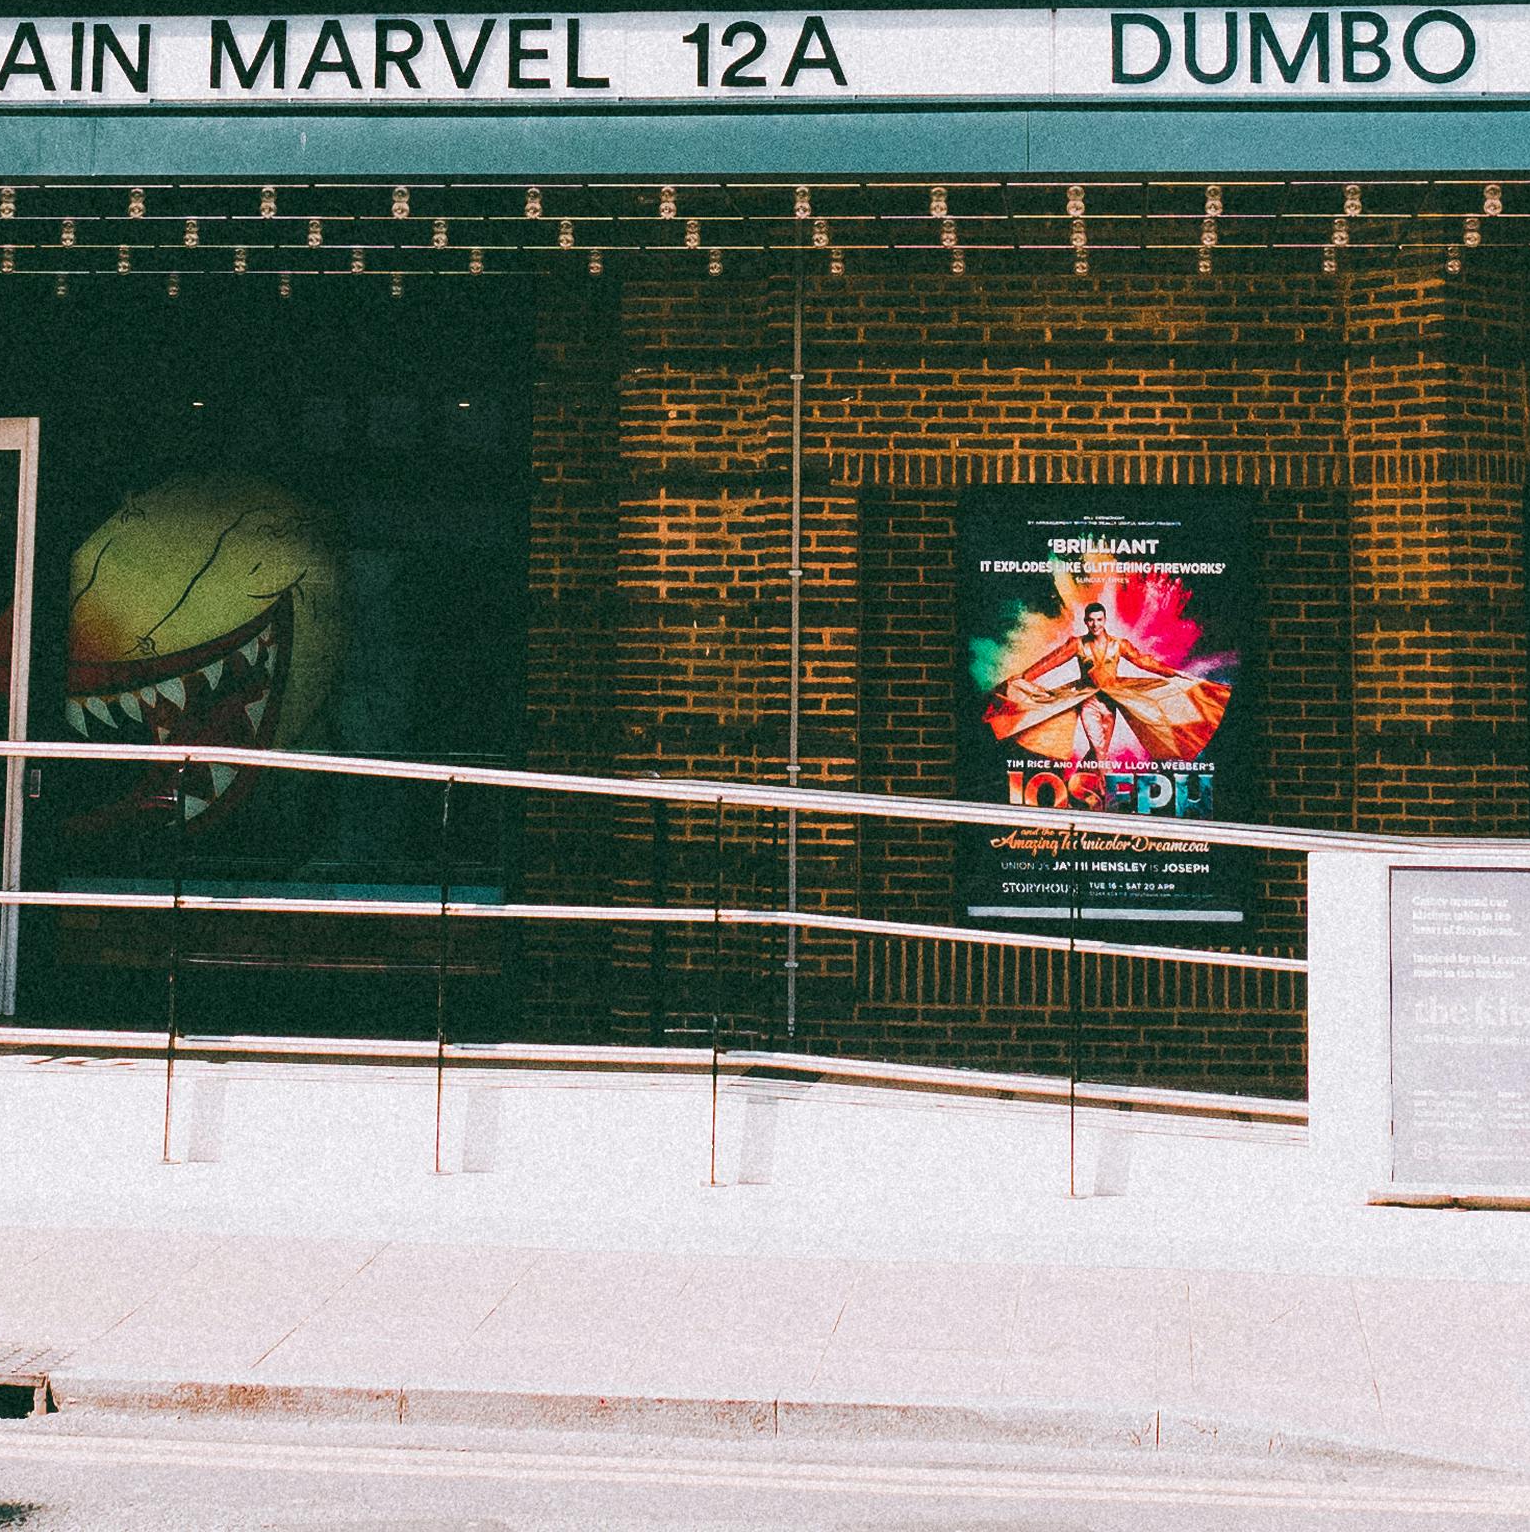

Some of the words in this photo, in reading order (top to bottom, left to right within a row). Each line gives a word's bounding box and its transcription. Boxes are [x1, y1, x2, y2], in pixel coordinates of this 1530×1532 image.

[210, 17, 610, 91] MARVEL
[683, 15, 848, 89] 12A
[1111, 8, 1477, 86] DUMBO
[980, 561, 992, 573] IT
[993, 561, 1053, 573] EXPLODES
[1055, 562, 1081, 573] LIKE
[1083, 562, 1152, 574] GLITTERING
[1006, 759, 1024, 768] TIM
[1027, 759, 1051, 769] RICE
[1054, 761, 1072, 769] AND
[1076, 760, 1122, 770] ANDREW
[1125, 761, 1158, 771] LLOYD
[1006, 770, 1214, 819] JOSEPH
[990, 829, 1059, 857] Amazing
[1001, 861, 1035, 871] UNION
[1091, 861, 1147, 873] HENSLEY
[1161, 862, 1209, 874] JOSEPH
[1089, 881, 1105, 889] TUE
[1125, 882, 1142, 890] SAT
[1413, 994, 1470, 1025] the
